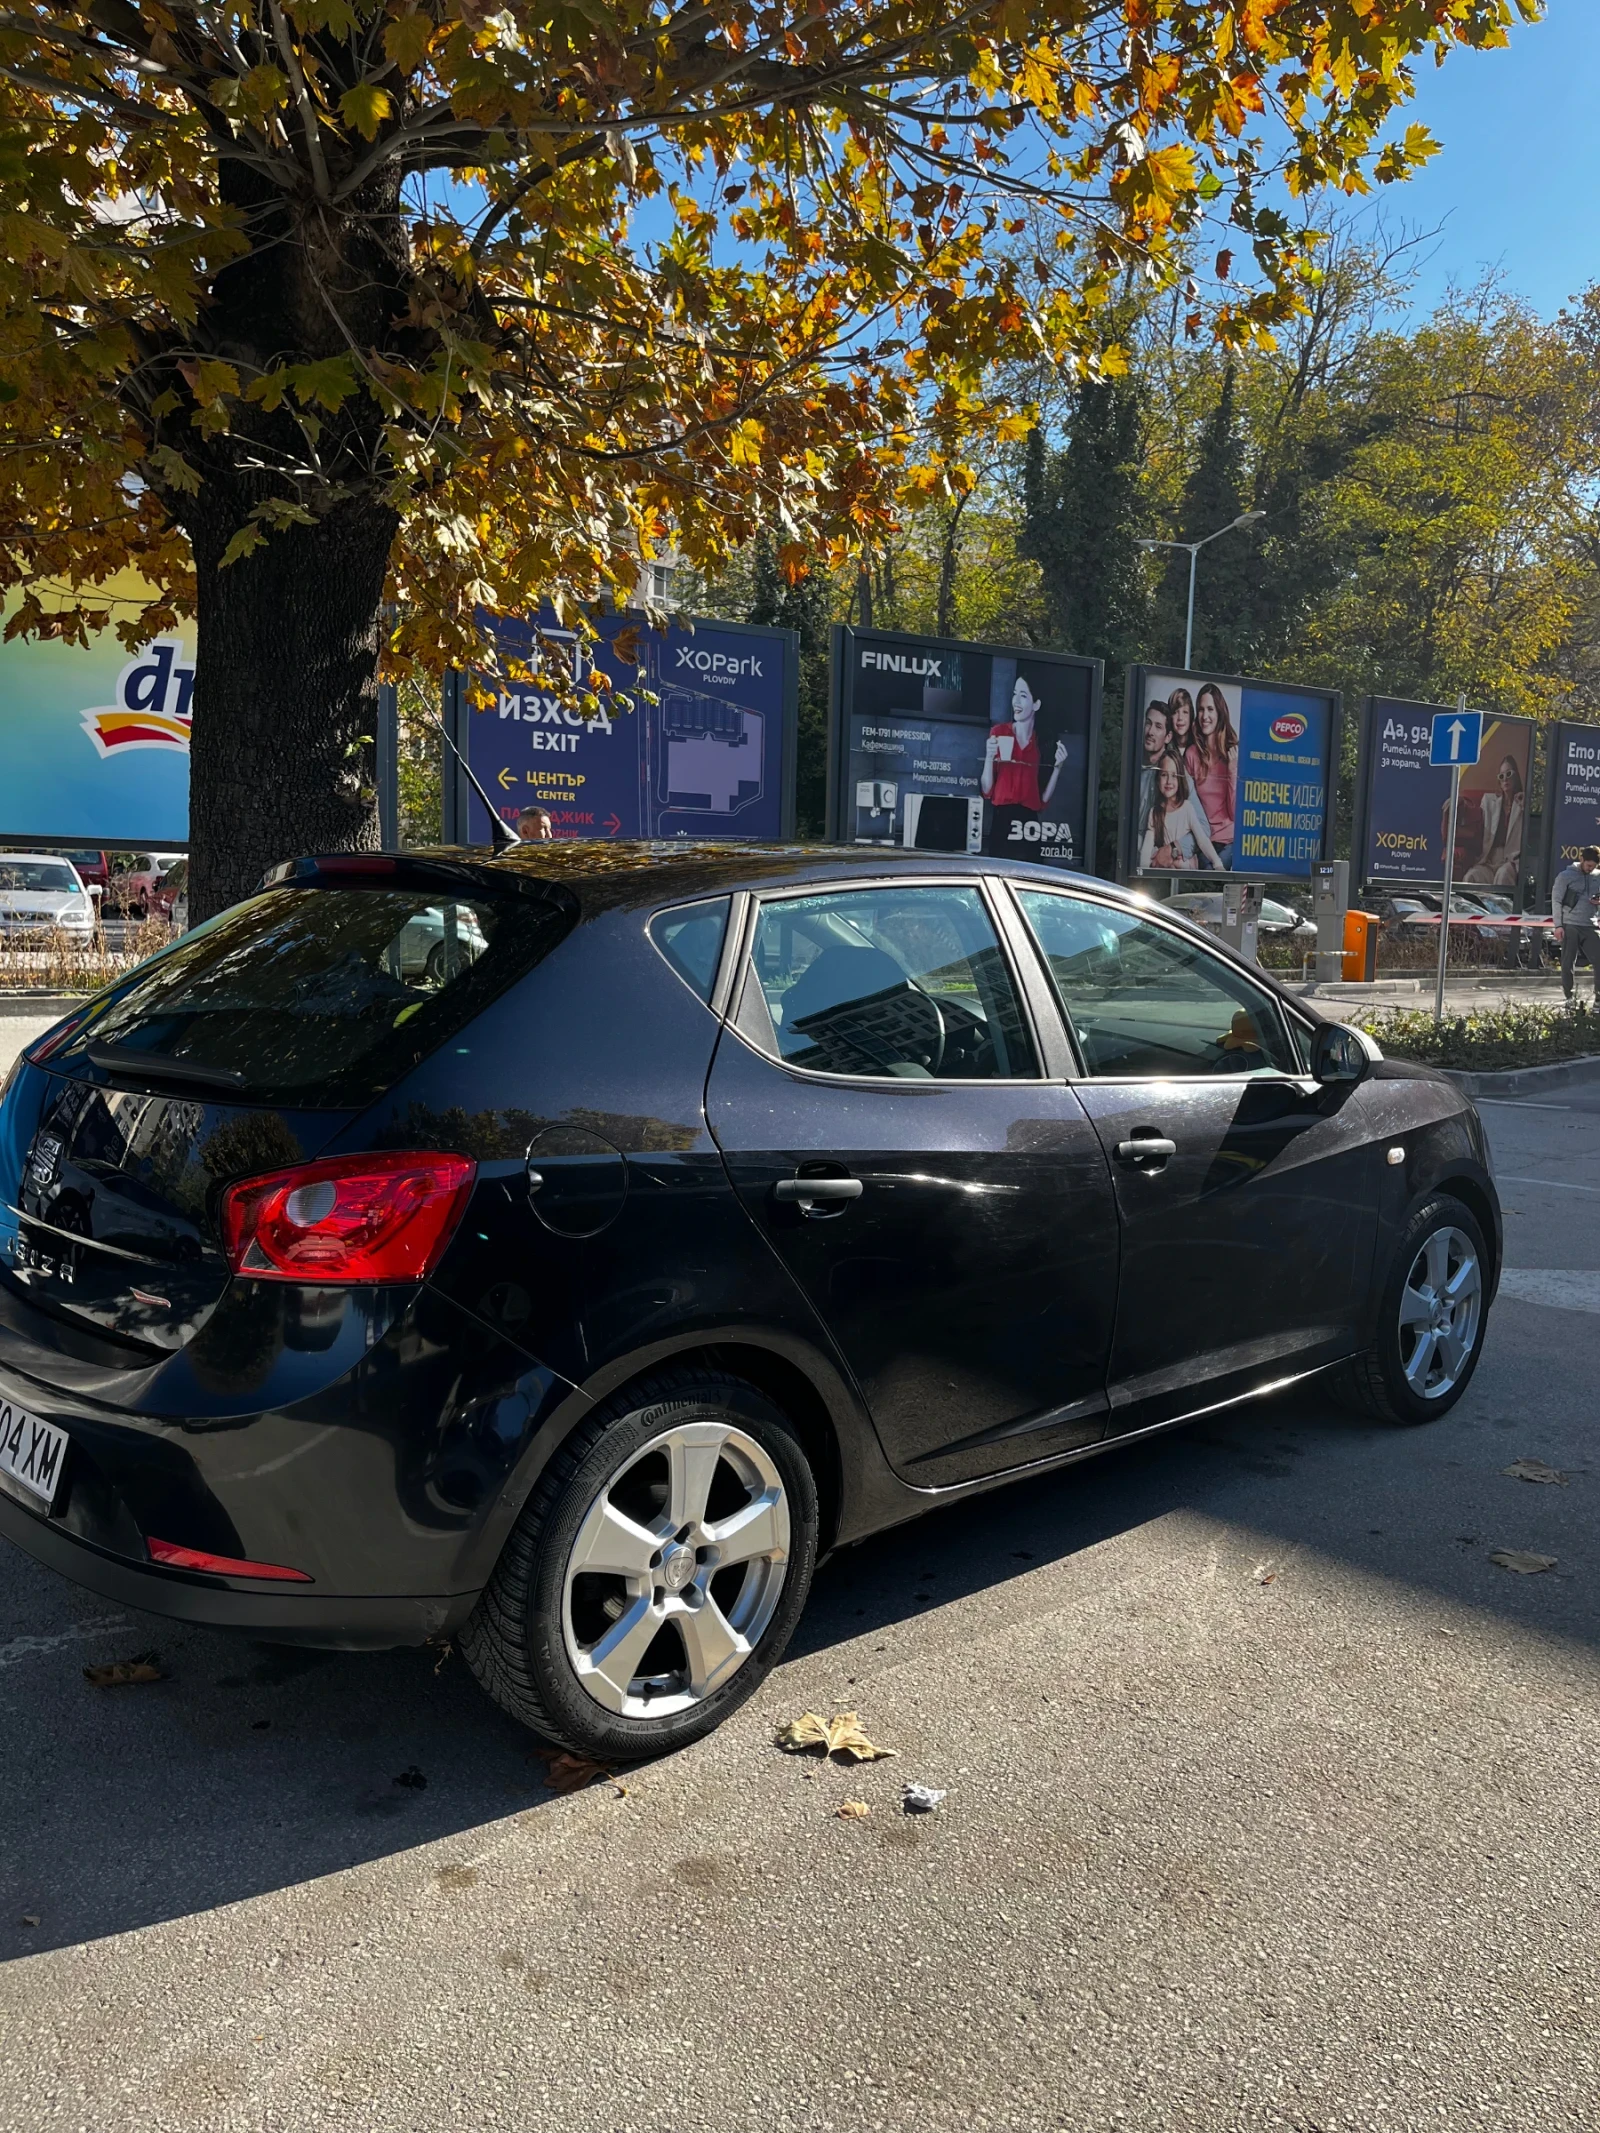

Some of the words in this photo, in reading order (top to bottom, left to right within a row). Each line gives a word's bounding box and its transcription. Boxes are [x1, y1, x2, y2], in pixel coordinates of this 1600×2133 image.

[675, 646, 763, 677] XOPark
[861, 651, 942, 677] FINLUX
[703, 674, 736, 685] PLOVDIV
[892, 730, 931, 741] IMPRESSION
[1275, 721, 1302, 734] PEPCO
[1383, 718, 1408, 741] Да,
[533, 731, 580, 752] EXIT
[1382, 742, 1411, 756] Ритейл
[1568, 741, 1595, 760] Ето
[1381, 757, 1390, 767] за
[526, 770, 586, 786] ЦЕНТЪР
[536, 790, 576, 801] CENTER
[1245, 781, 1290, 805] ПОВЕЧЕ
[1292, 785, 1324, 809] ИДЕИ
[501, 807, 595, 825] ПАДЖИК
[1243, 809, 1292, 829] ПО-ГОЛЯМ
[1294, 813, 1322, 831] ИЗБОР
[1007, 820, 1073, 843] ЗОРА
[1376, 831, 1428, 850] XOPark
[1040, 845, 1073, 860] zora.bg
[1242, 834, 1285, 858] НИСКИ
[1288, 837, 1321, 861] ЦЕНИ
[641, 1389, 712, 1427] Continental
